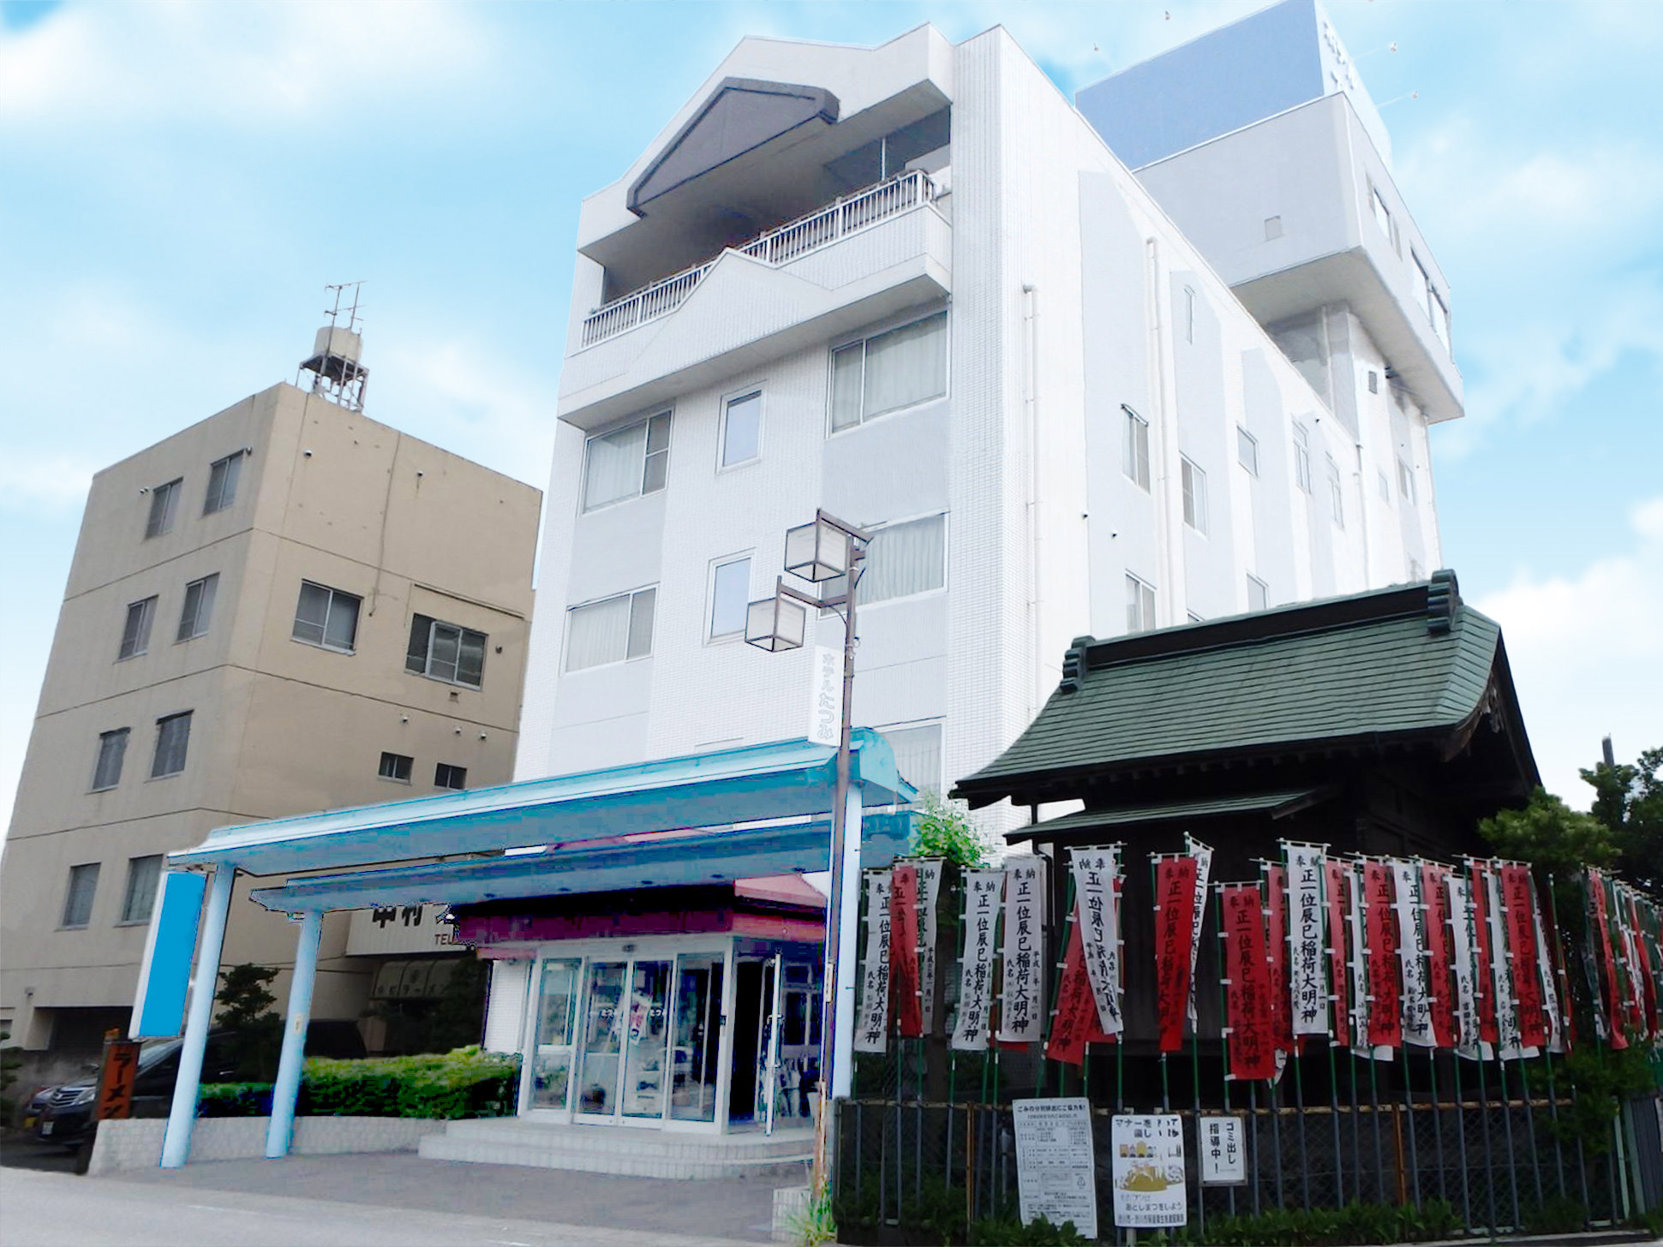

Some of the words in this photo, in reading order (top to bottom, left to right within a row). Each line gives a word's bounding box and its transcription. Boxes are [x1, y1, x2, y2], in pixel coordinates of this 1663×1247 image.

[963, 895, 990, 1042] 正一位辰巳稲荷大明神
[1012, 882, 1032, 1035] 正一位辰巳稲荷大明神
[1300, 868, 1319, 1024] 正一位辰巳稲荷大明神
